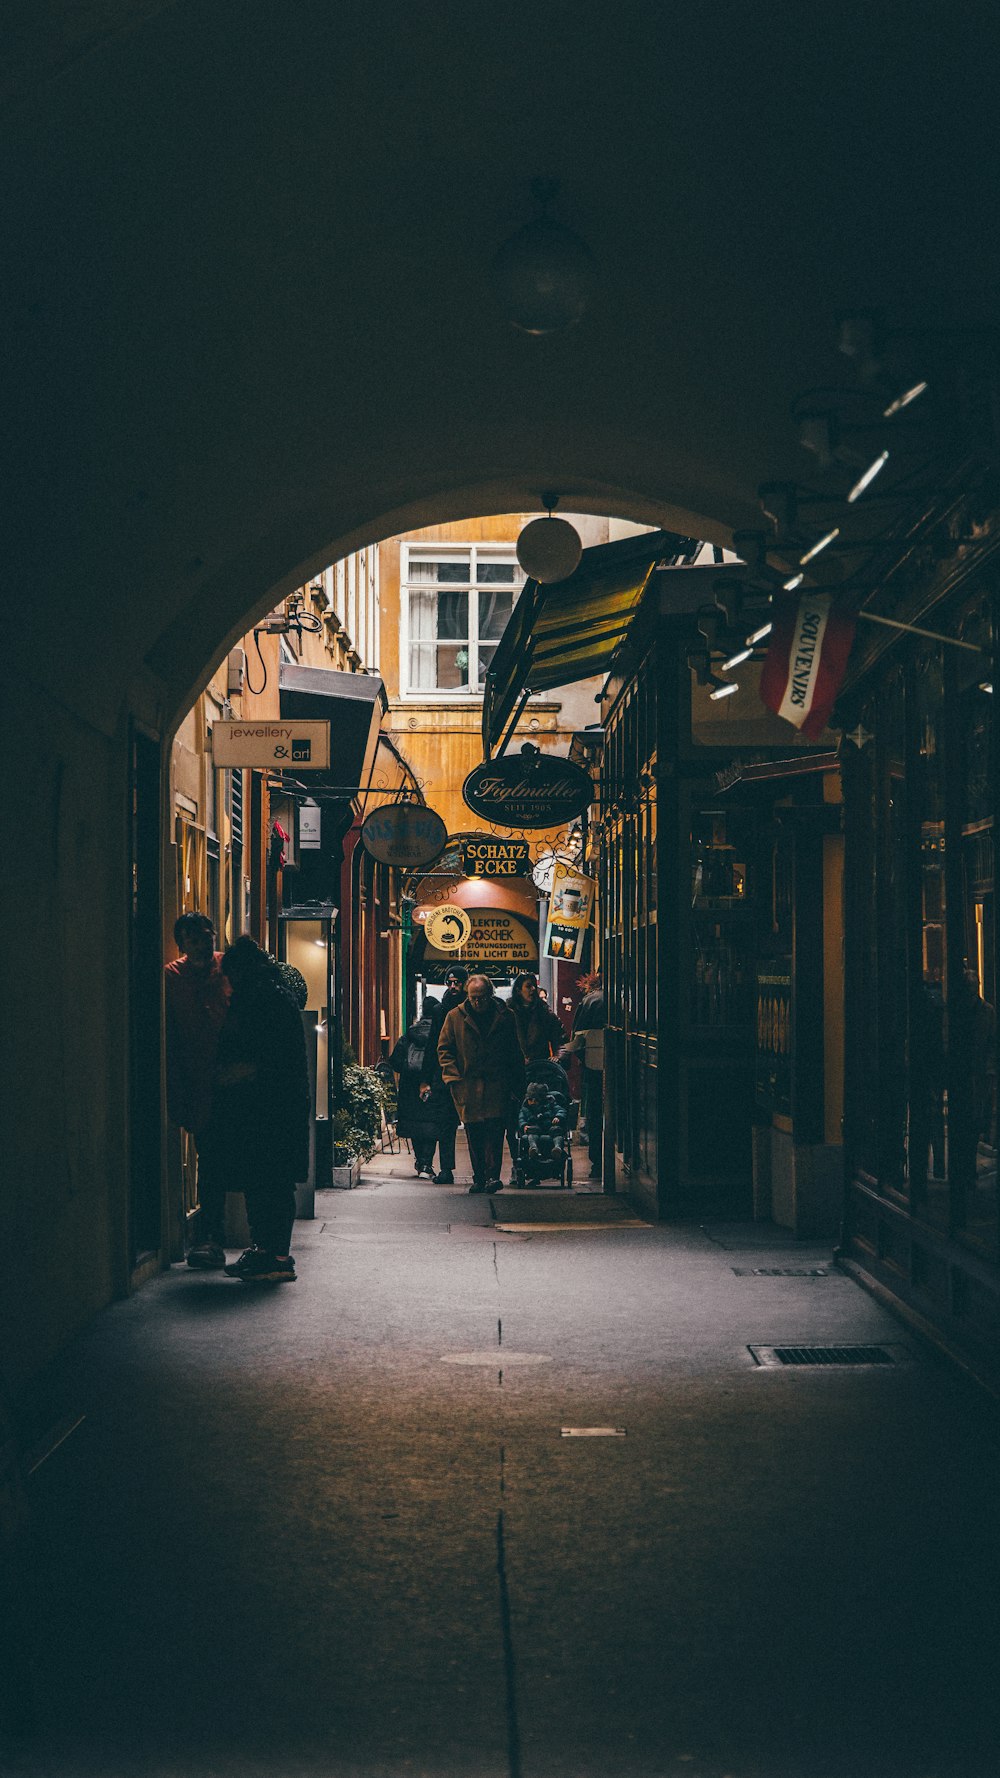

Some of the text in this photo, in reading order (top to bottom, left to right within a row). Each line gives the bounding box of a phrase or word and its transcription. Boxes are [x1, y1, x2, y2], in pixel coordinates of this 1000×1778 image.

[791, 612, 821, 708] SOUVENIRS
[230, 727, 292, 740] jewellery
[273, 745, 310, 759] & art
[474, 777, 579, 803] Figlmüller
[504, 804, 552, 812] SEIT 1905
[466, 844, 527, 859] SCHATZ-
[474, 860, 517, 874] ECKE
[418, 911, 432, 919] AT
[470, 919, 510, 928] LEKTRO
[449, 950, 530, 958] DESIGN LICHT BAD
